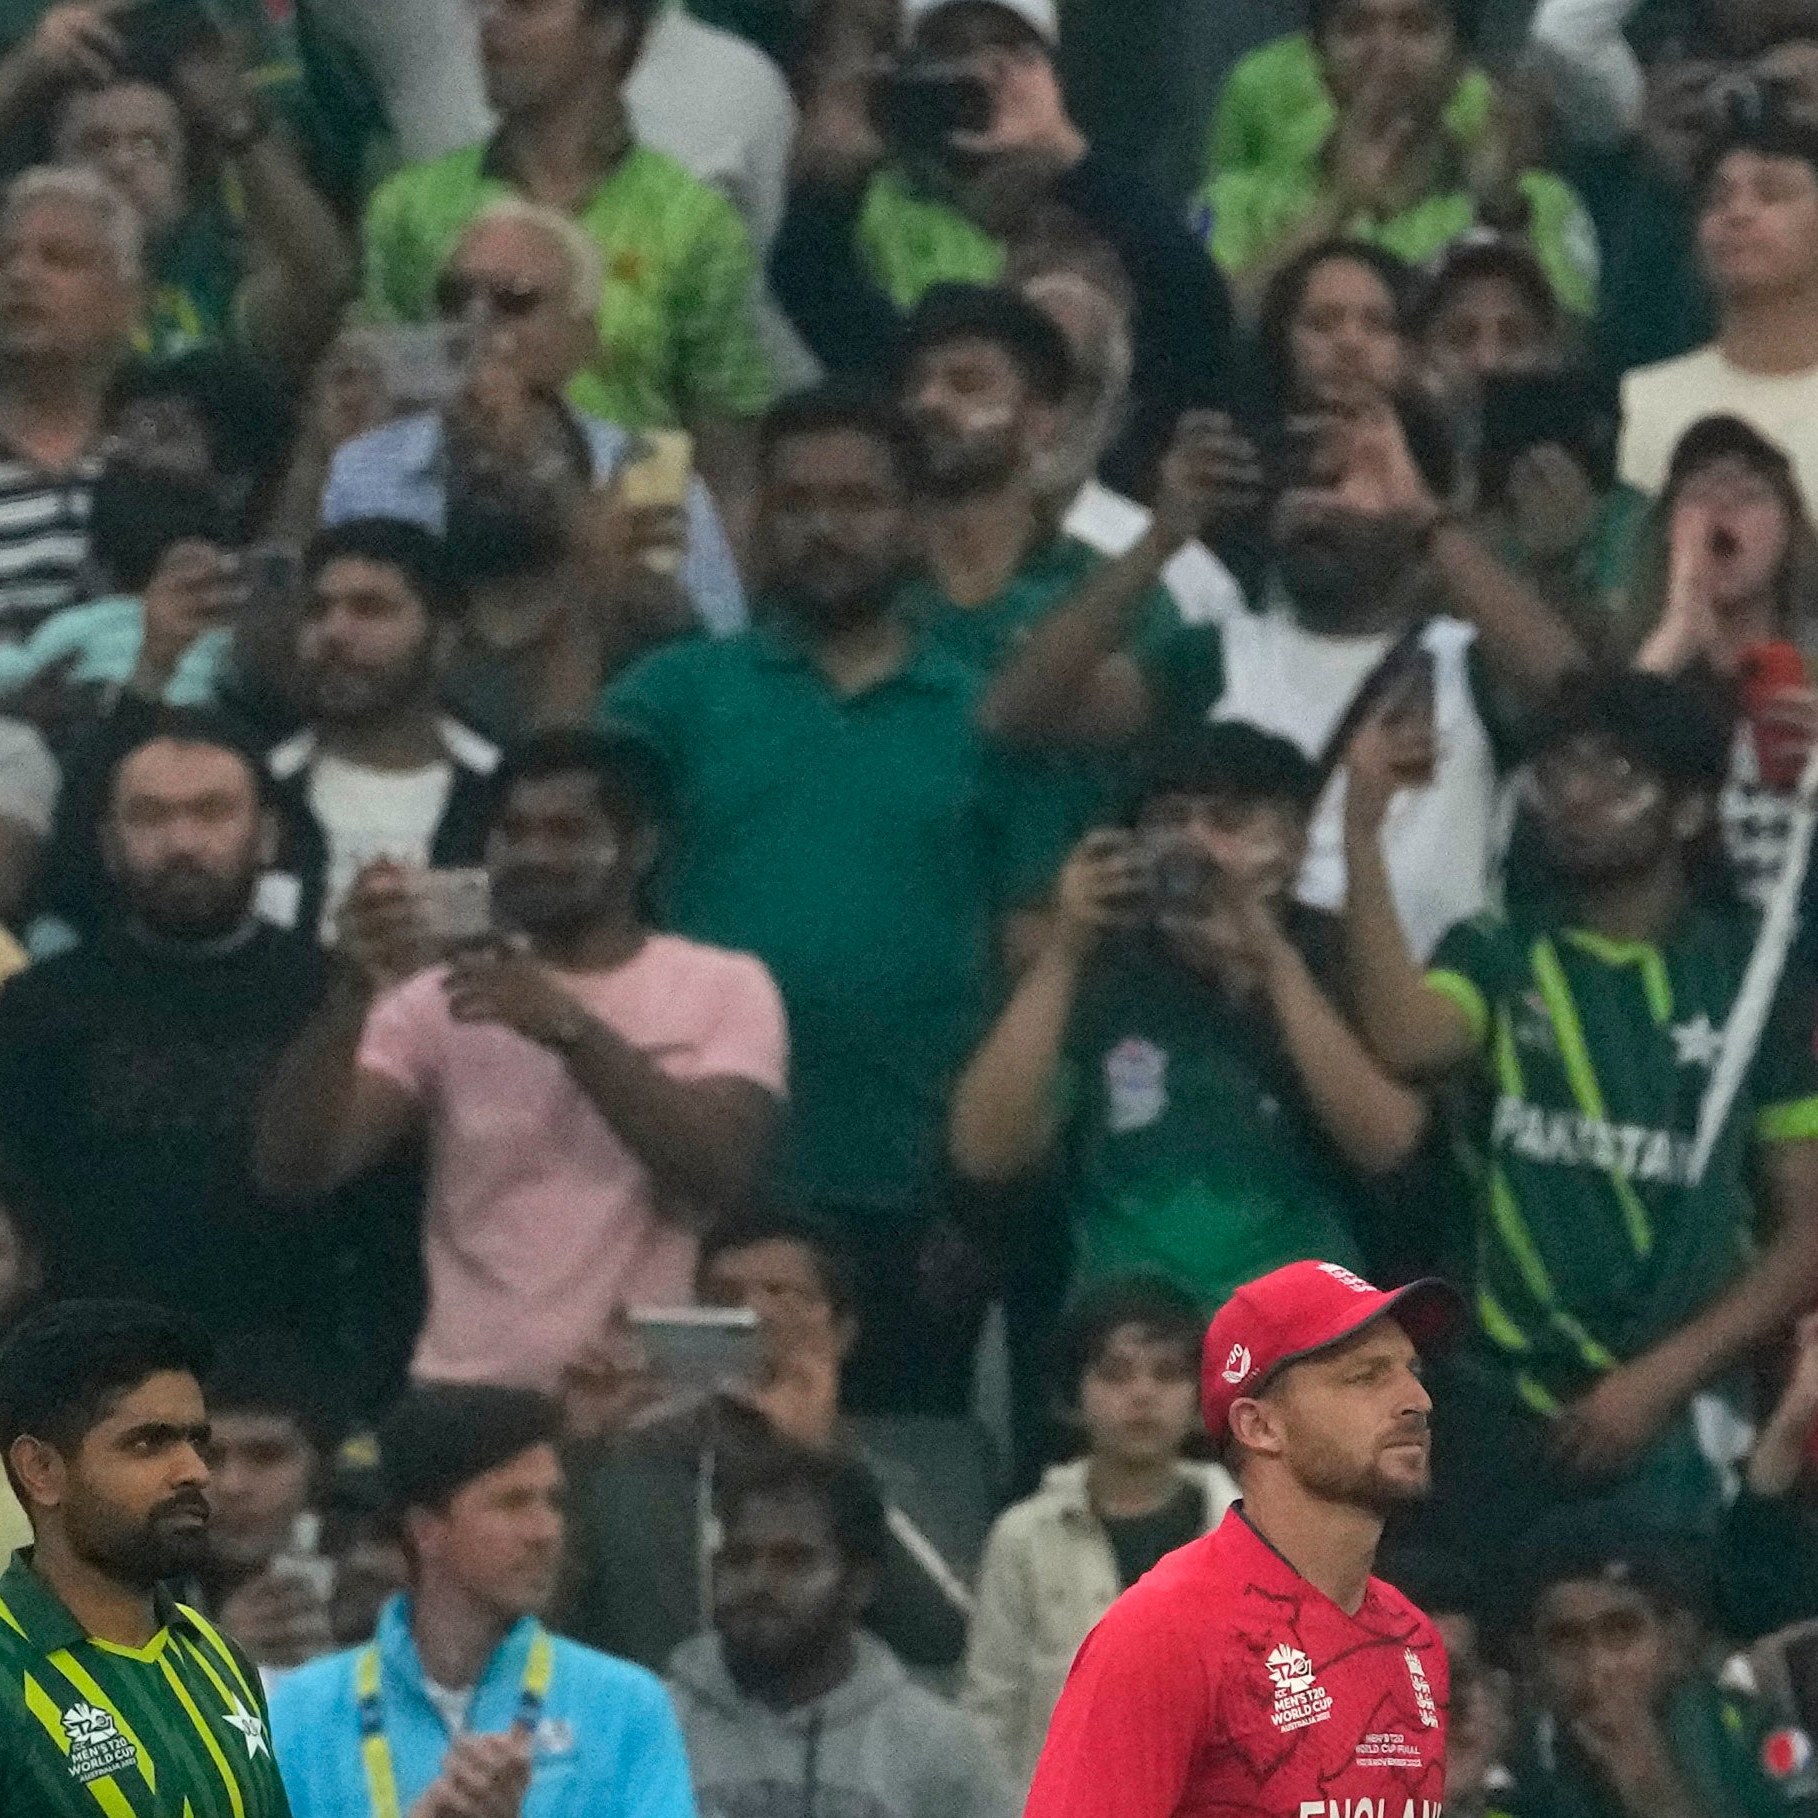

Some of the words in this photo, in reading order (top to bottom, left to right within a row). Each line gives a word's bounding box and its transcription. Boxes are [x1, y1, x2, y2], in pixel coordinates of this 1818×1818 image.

[1271, 1704, 1312, 1726] WORLD
[1313, 1697, 1333, 1713] CUP
[1274, 1692, 1308, 1712] MEN'S
[1308, 1687, 1326, 1701] T20
[67, 1752, 114, 1777] WORLD
[114, 1745, 136, 1760] CUP
[71, 1743, 109, 1764] MEN'S
